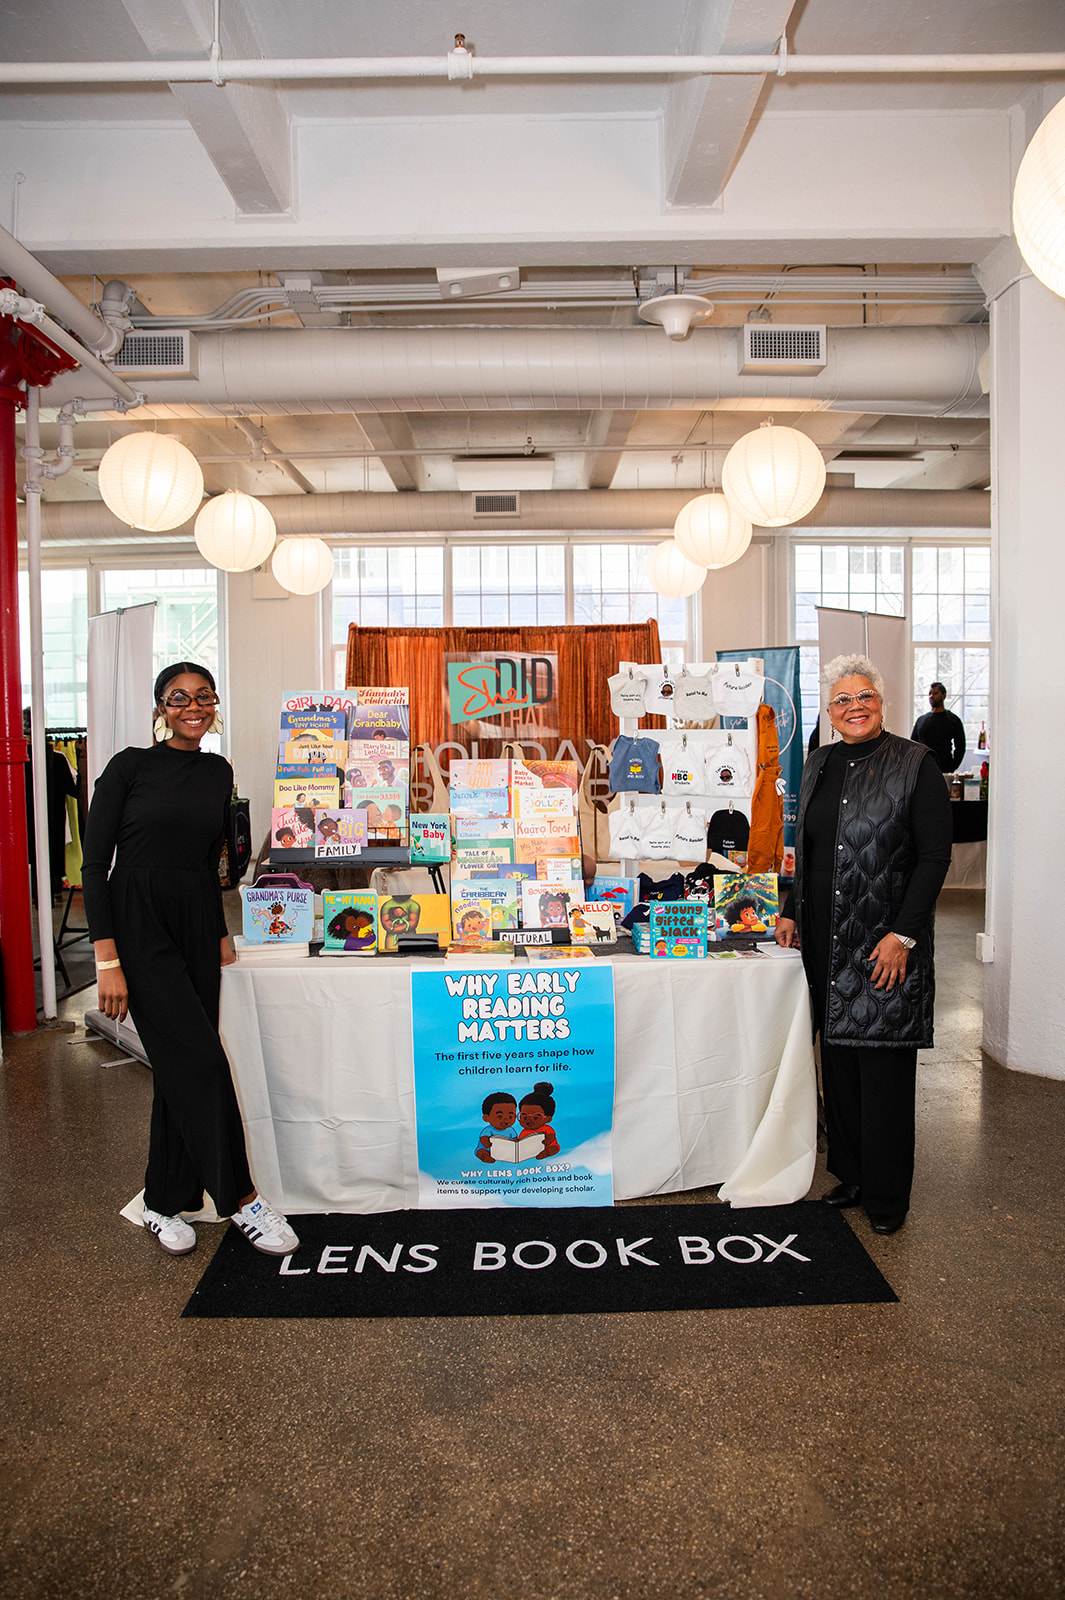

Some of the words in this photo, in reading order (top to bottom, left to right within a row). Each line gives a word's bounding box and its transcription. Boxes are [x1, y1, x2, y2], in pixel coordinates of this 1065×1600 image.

[458, 665, 529, 715] She
[496, 658, 553, 704] DID
[360, 689, 405, 698] Hannah's
[324, 696, 354, 711] DAD
[288, 714, 338, 724] Grandma's
[368, 710, 388, 719] Dear
[496, 706, 548, 732] THAT
[354, 719, 401, 729] Grandbaby
[466, 763, 473, 775] I
[474, 762, 493, 776] AM
[672, 773, 693, 781] HBCU
[529, 799, 565, 808] JOLLOF
[277, 812, 299, 829] Just
[292, 823, 308, 836] like
[337, 822, 364, 838] BIG
[298, 835, 314, 847] you
[423, 830, 445, 841] Baby
[318, 845, 357, 856] FAMILY
[246, 891, 284, 902] GRANDMA'S
[287, 891, 308, 904] PURSE
[325, 895, 336, 904] ME
[342, 896, 353, 904] MY
[354, 896, 376, 905] MAMA
[578, 904, 612, 912] HELLO!
[665, 906, 702, 914] young
[492, 912, 499, 920] C
[656, 916, 694, 926] gifted
[661, 927, 698, 937] black
[502, 933, 550, 944] CULTURAL
[445, 974, 499, 997] WHY
[507, 971, 580, 995] EARLY
[462, 996, 565, 1020] READING
[458, 1018, 571, 1043] MATTERS
[435, 1052, 455, 1061] The
[458, 1051, 479, 1061] first
[482, 1050, 501, 1059] five
[504, 1050, 534, 1061] years
[537, 1048, 570, 1060] shape
[572, 1048, 594, 1056] how
[458, 1066, 503, 1076] children
[506, 1064, 532, 1073] learn
[535, 1064, 550, 1072] for
[552, 1063, 572, 1072] life.
[461, 1170, 484, 1178] WHY
[487, 1169, 512, 1177] LENS
[516, 1167, 541, 1176] BOOK
[545, 1163, 571, 1174] BOX?
[478, 1178, 515, 1186] culturally
[470, 1187, 500, 1195] support
[503, 1187, 519, 1195] your
[522, 1186, 563, 1194] developing
[280, 1242, 440, 1275] LENS
[473, 1237, 660, 1271] BOOK
[678, 1233, 812, 1264] BOX
